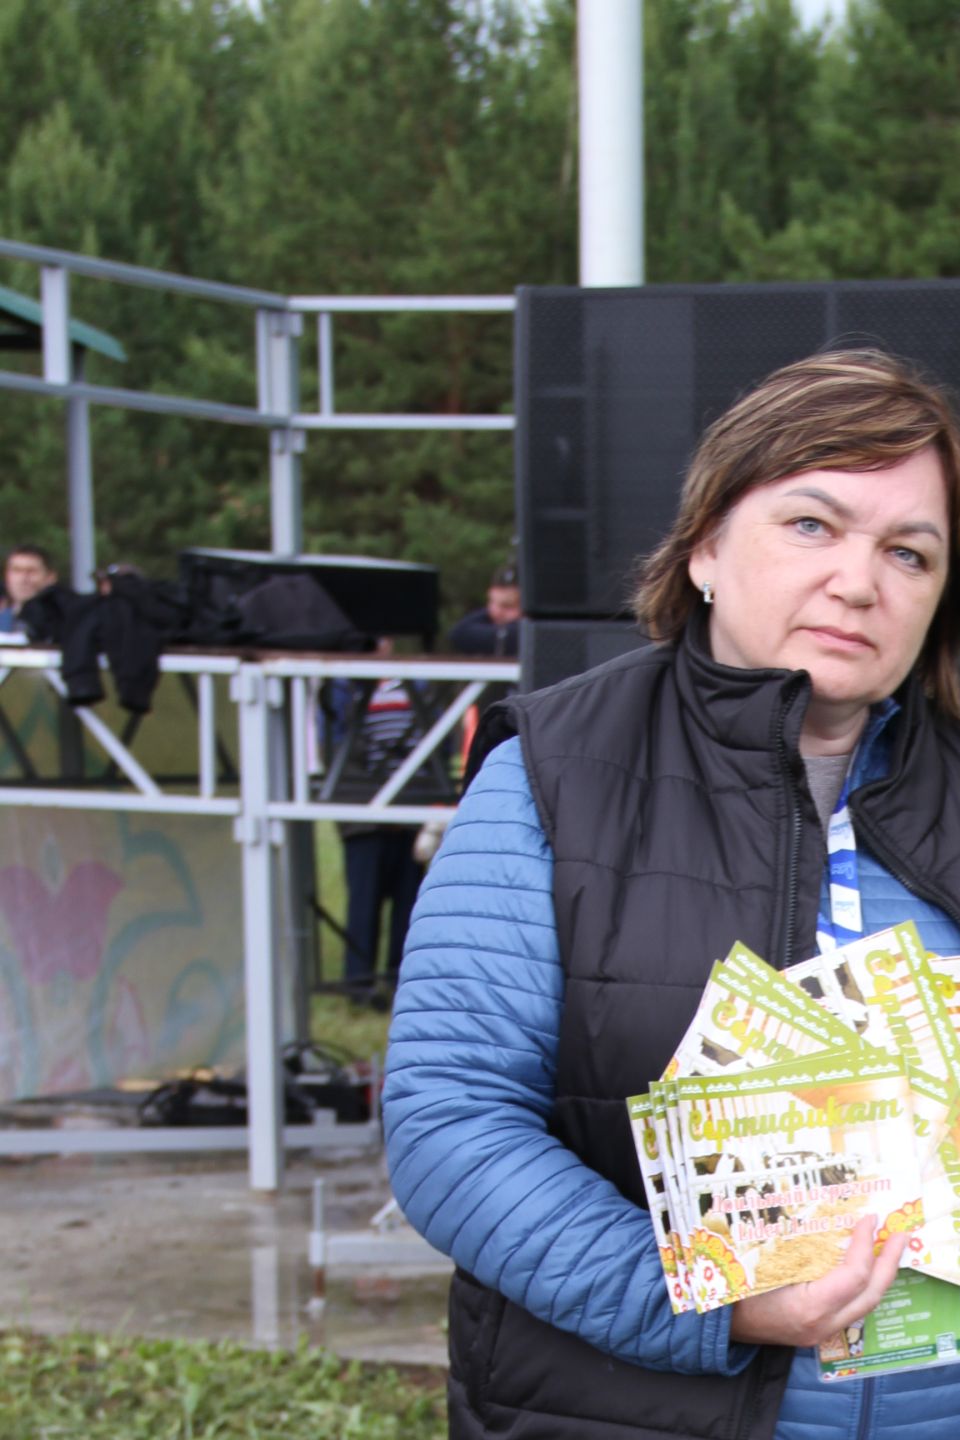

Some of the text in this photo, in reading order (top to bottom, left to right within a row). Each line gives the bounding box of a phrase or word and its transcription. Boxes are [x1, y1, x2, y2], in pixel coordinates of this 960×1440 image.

[688, 1095, 904, 1153] Сертификат
[809, 1178, 892, 1204] агрегат
[737, 1218, 781, 1241] Lider
[791, 1215, 830, 1235] Line
